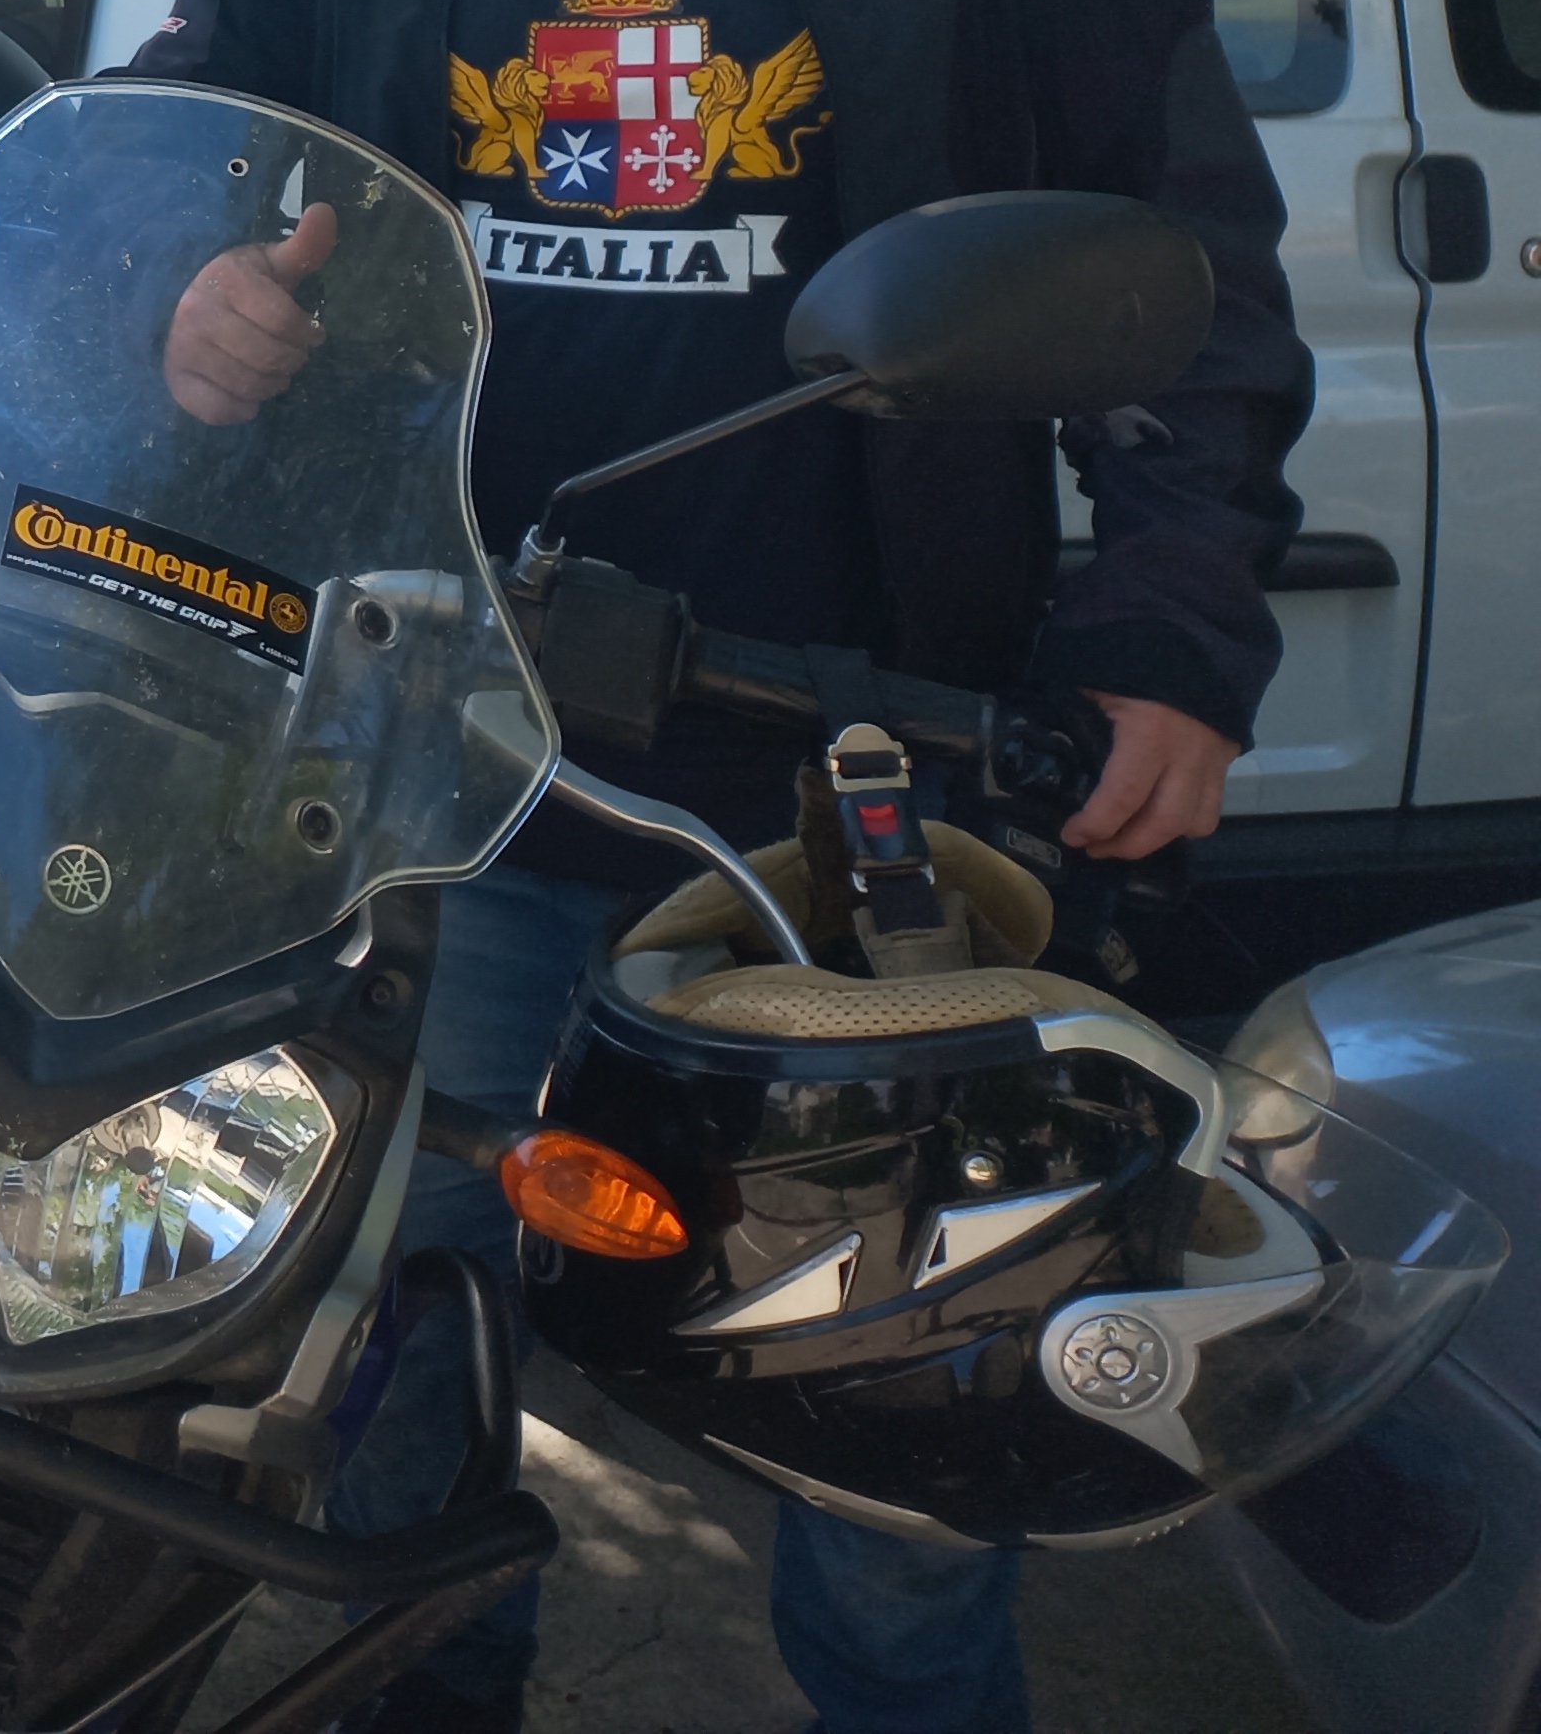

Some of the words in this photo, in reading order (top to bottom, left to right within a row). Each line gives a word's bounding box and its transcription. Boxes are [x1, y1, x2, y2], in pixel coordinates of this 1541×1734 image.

[485, 227, 730, 284] ITALIA
[15, 503, 269, 620] Continental
[88, 573, 135, 596] GET
[138, 589, 177, 613] THE
[179, 605, 229, 630] GRIP
